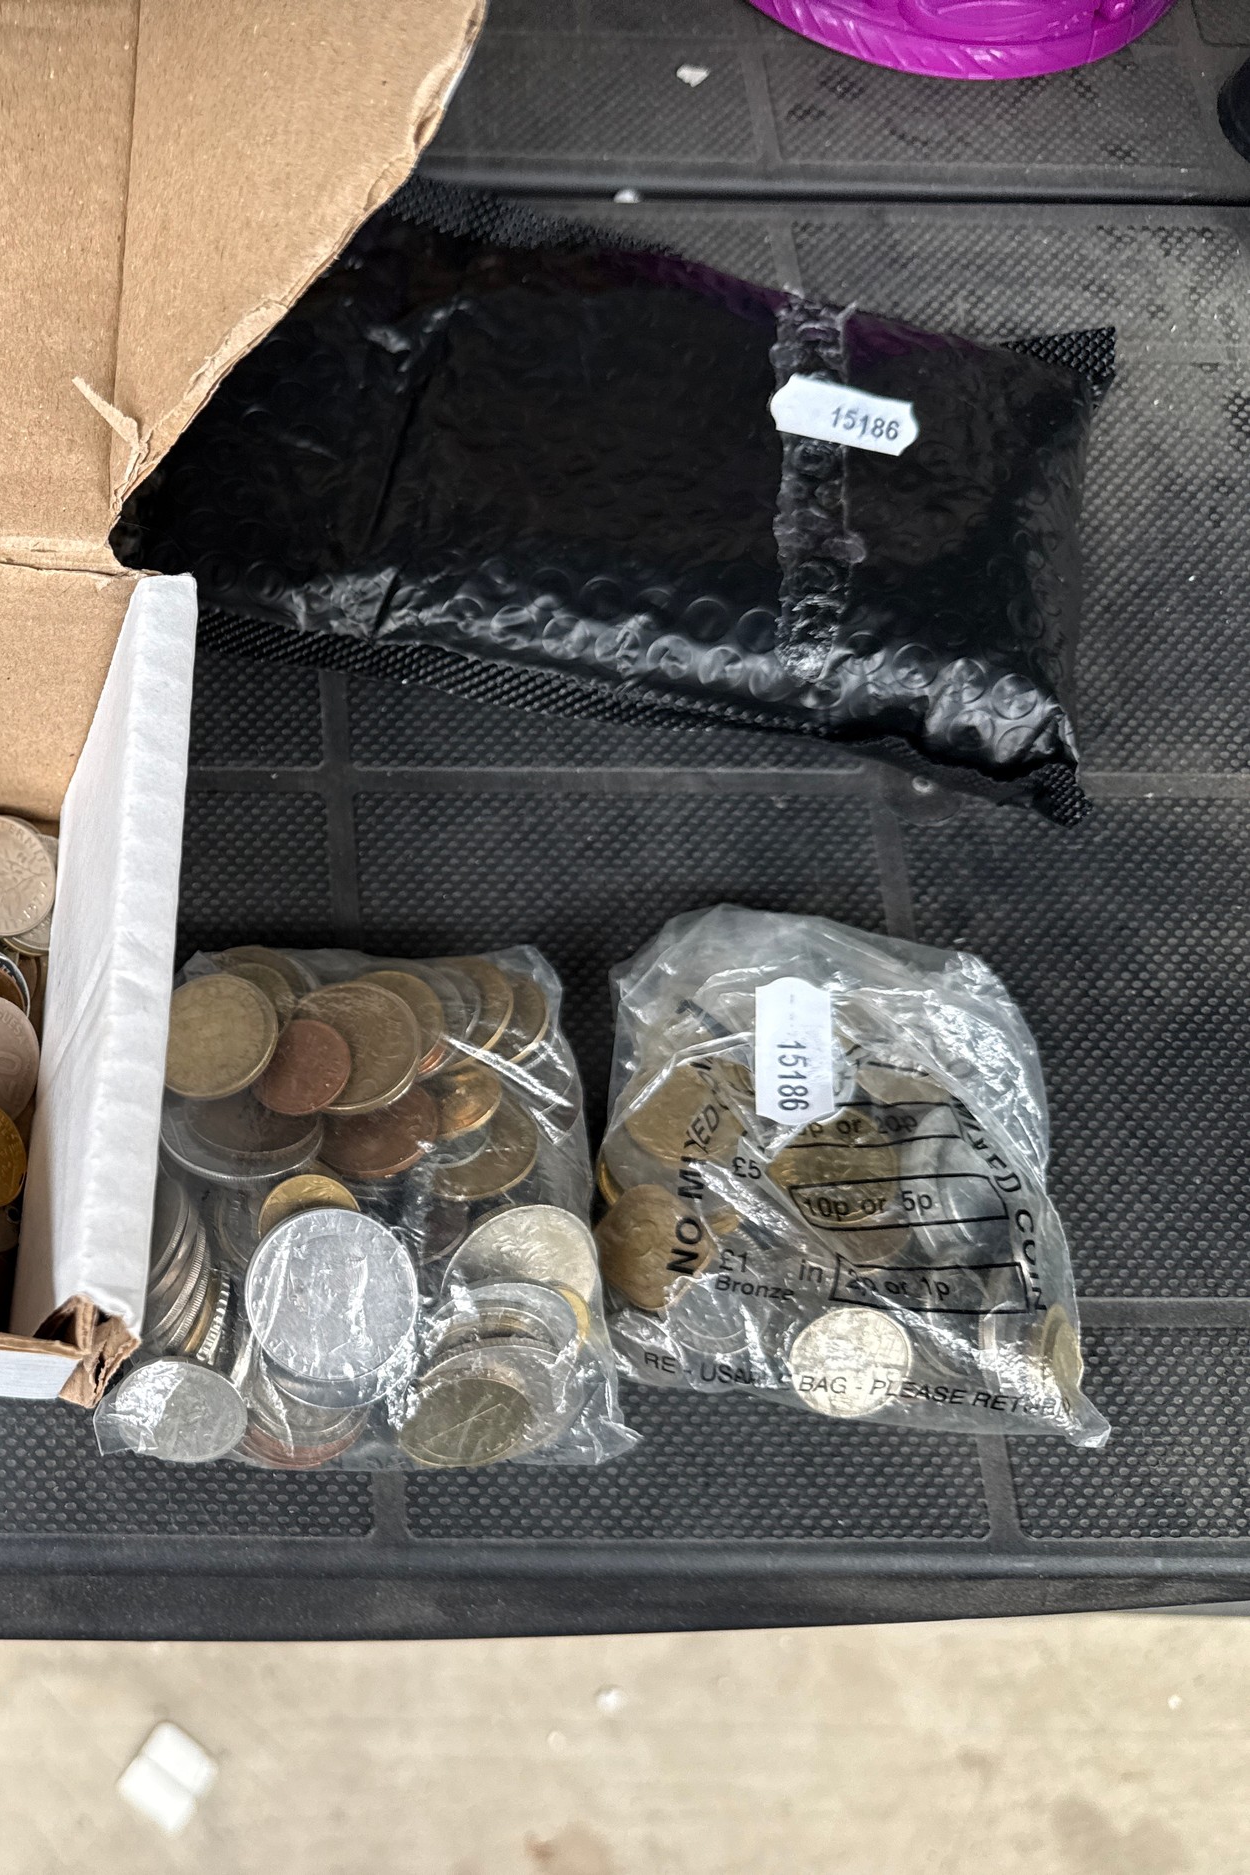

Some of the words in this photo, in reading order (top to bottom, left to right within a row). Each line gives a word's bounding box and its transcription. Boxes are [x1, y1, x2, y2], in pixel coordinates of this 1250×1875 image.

[831, 406, 900, 441] 15186
[776, 1040, 810, 1112] 15186
[836, 1118, 862, 1135] or
[731, 1156, 762, 1181] £5
[803, 1196, 850, 1222] 10p
[861, 1196, 887, 1215] or
[901, 1190, 934, 1217] 5p
[666, 1216, 704, 1276] NO
[719, 1248, 749, 1274] £1
[800, 1258, 824, 1284] in
[714, 1274, 795, 1301] Bronze
[883, 1279, 909, 1297] or
[920, 1275, 951, 1301] 1p
[644, 1350, 677, 1374] RE
[798, 1374, 848, 1394] BAG
[869, 1379, 967, 1406] PLEASE
